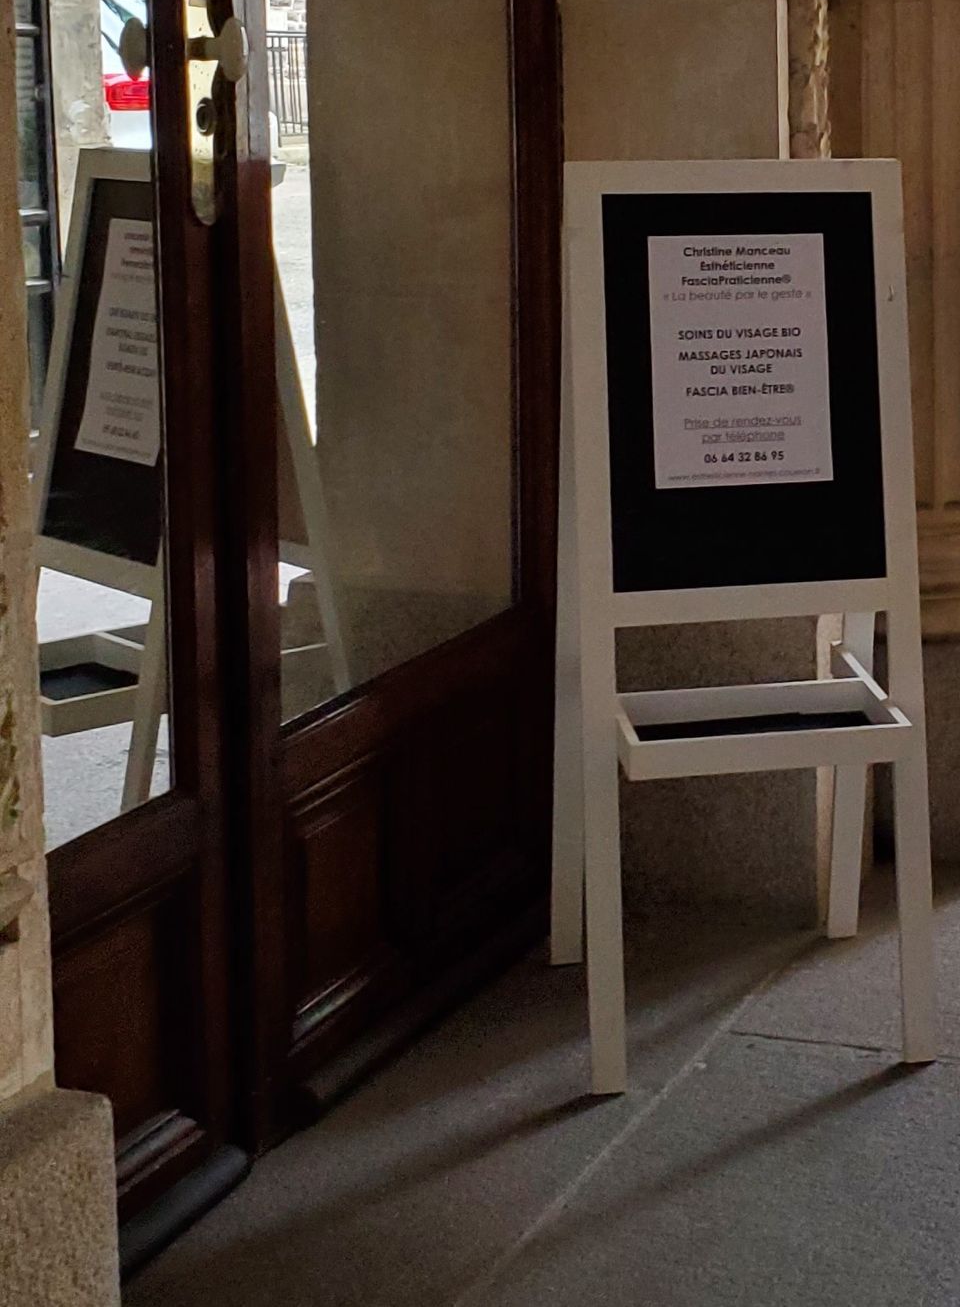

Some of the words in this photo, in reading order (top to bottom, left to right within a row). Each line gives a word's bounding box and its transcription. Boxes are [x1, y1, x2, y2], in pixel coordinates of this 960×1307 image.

[683, 246, 732, 257] Christine
[735, 245, 791, 256] Manceau
[700, 260, 776, 271] Esthéticienne
[671, 291, 686, 301] La
[688, 289, 732, 301] beauté
[735, 291, 755, 302] par
[757, 289, 768, 299] le
[770, 289, 803, 302] geste
[678, 329, 713, 340] SOINS
[716, 328, 732, 339] DU
[735, 327, 779, 338] VISAGE
[781, 327, 801, 337] BIO
[678, 350, 742, 361] MASSAGES
[745, 348, 803, 359] JAPONAIS
[710, 365, 726, 375] DU
[730, 363, 773, 374] VISAGE
[686, 386, 728, 397] FASCIA
[684, 418, 709, 430] Prise
[713, 417, 728, 429] de
[732, 415, 801, 428] rendez-vous
[702, 434, 722, 445] par
[726, 431, 785, 444] téléphone
[703, 453, 718, 463] 06
[721, 452, 735, 463] 64
[738, 452, 751, 462] 32
[754, 451, 768, 461] 86
[771, 450, 785, 460] 95
